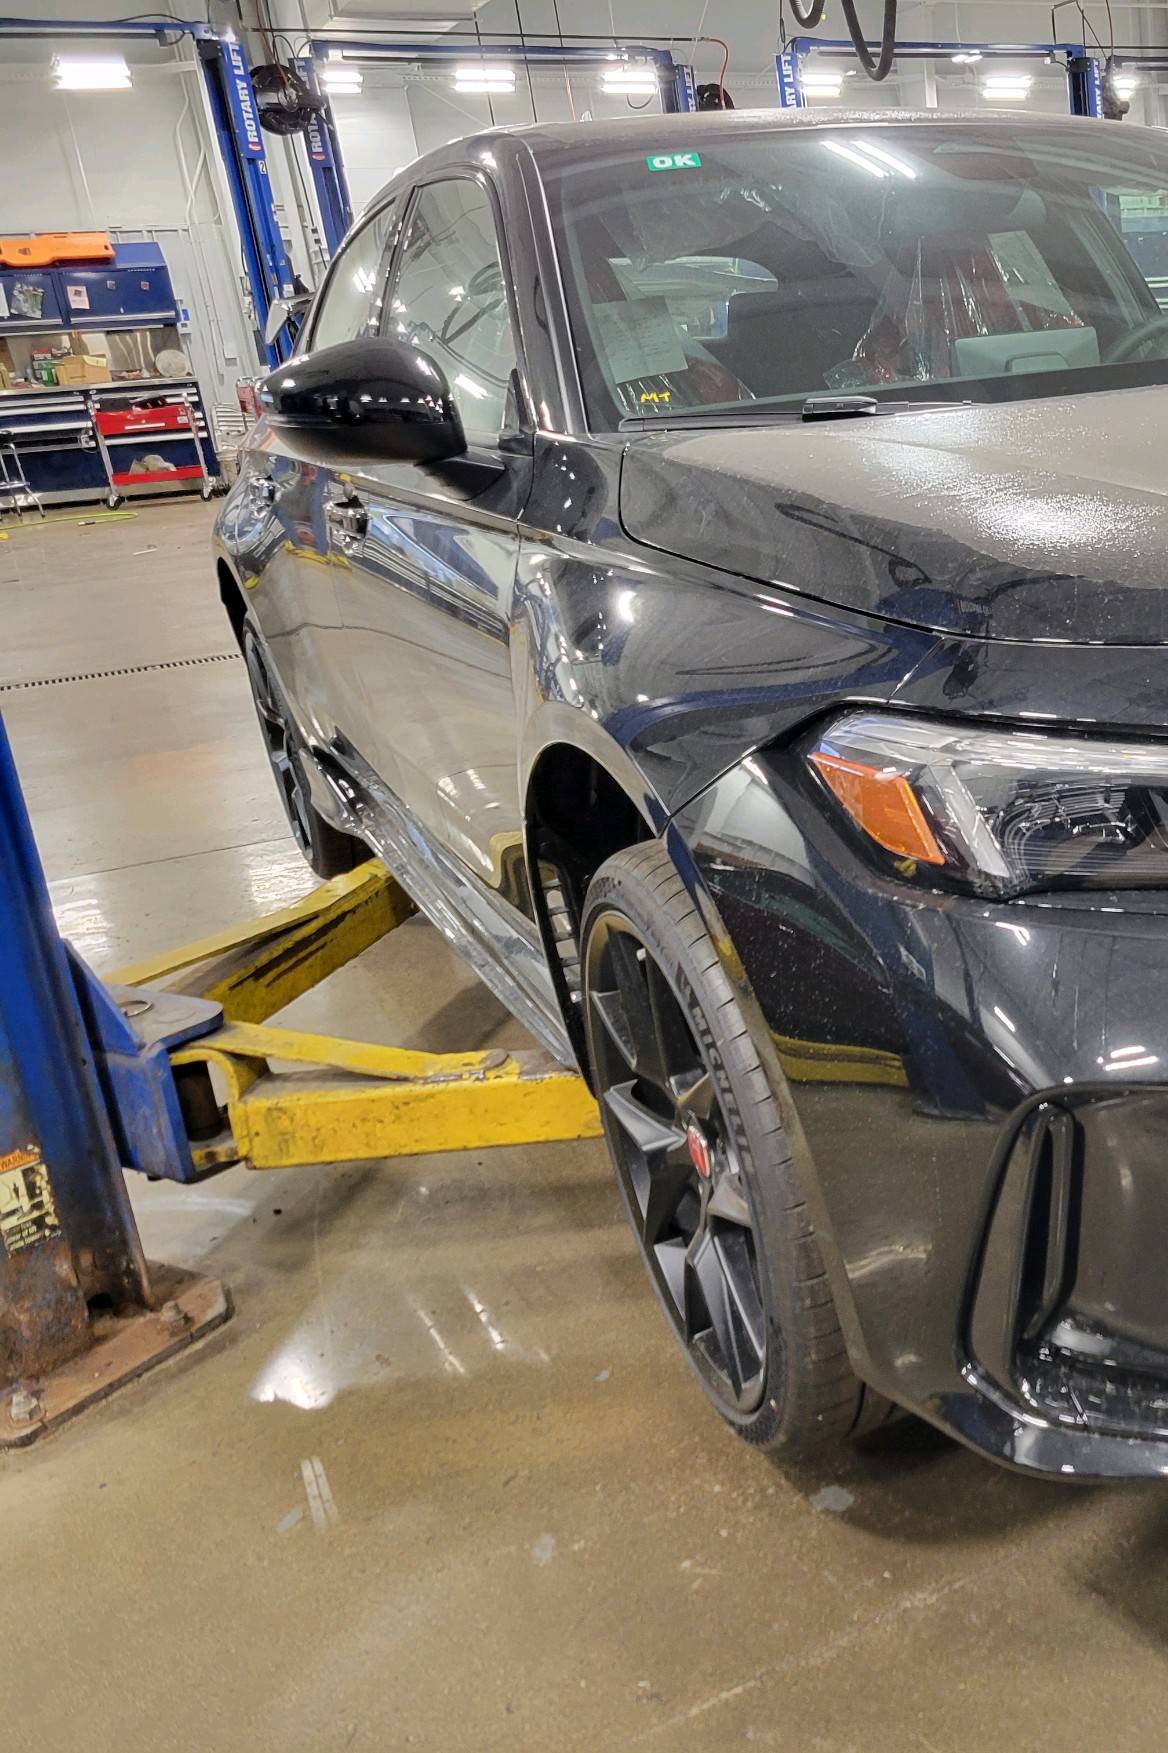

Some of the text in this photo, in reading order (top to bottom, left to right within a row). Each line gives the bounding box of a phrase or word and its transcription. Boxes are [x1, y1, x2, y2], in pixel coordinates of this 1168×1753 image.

[782, 52, 795, 83] LIFT
[229, 42, 259, 142] ROTARY LIFT
[653, 153, 696, 168] OK
[640, 391, 671, 403] MT
[689, 1005, 757, 1177] MICHELIN
